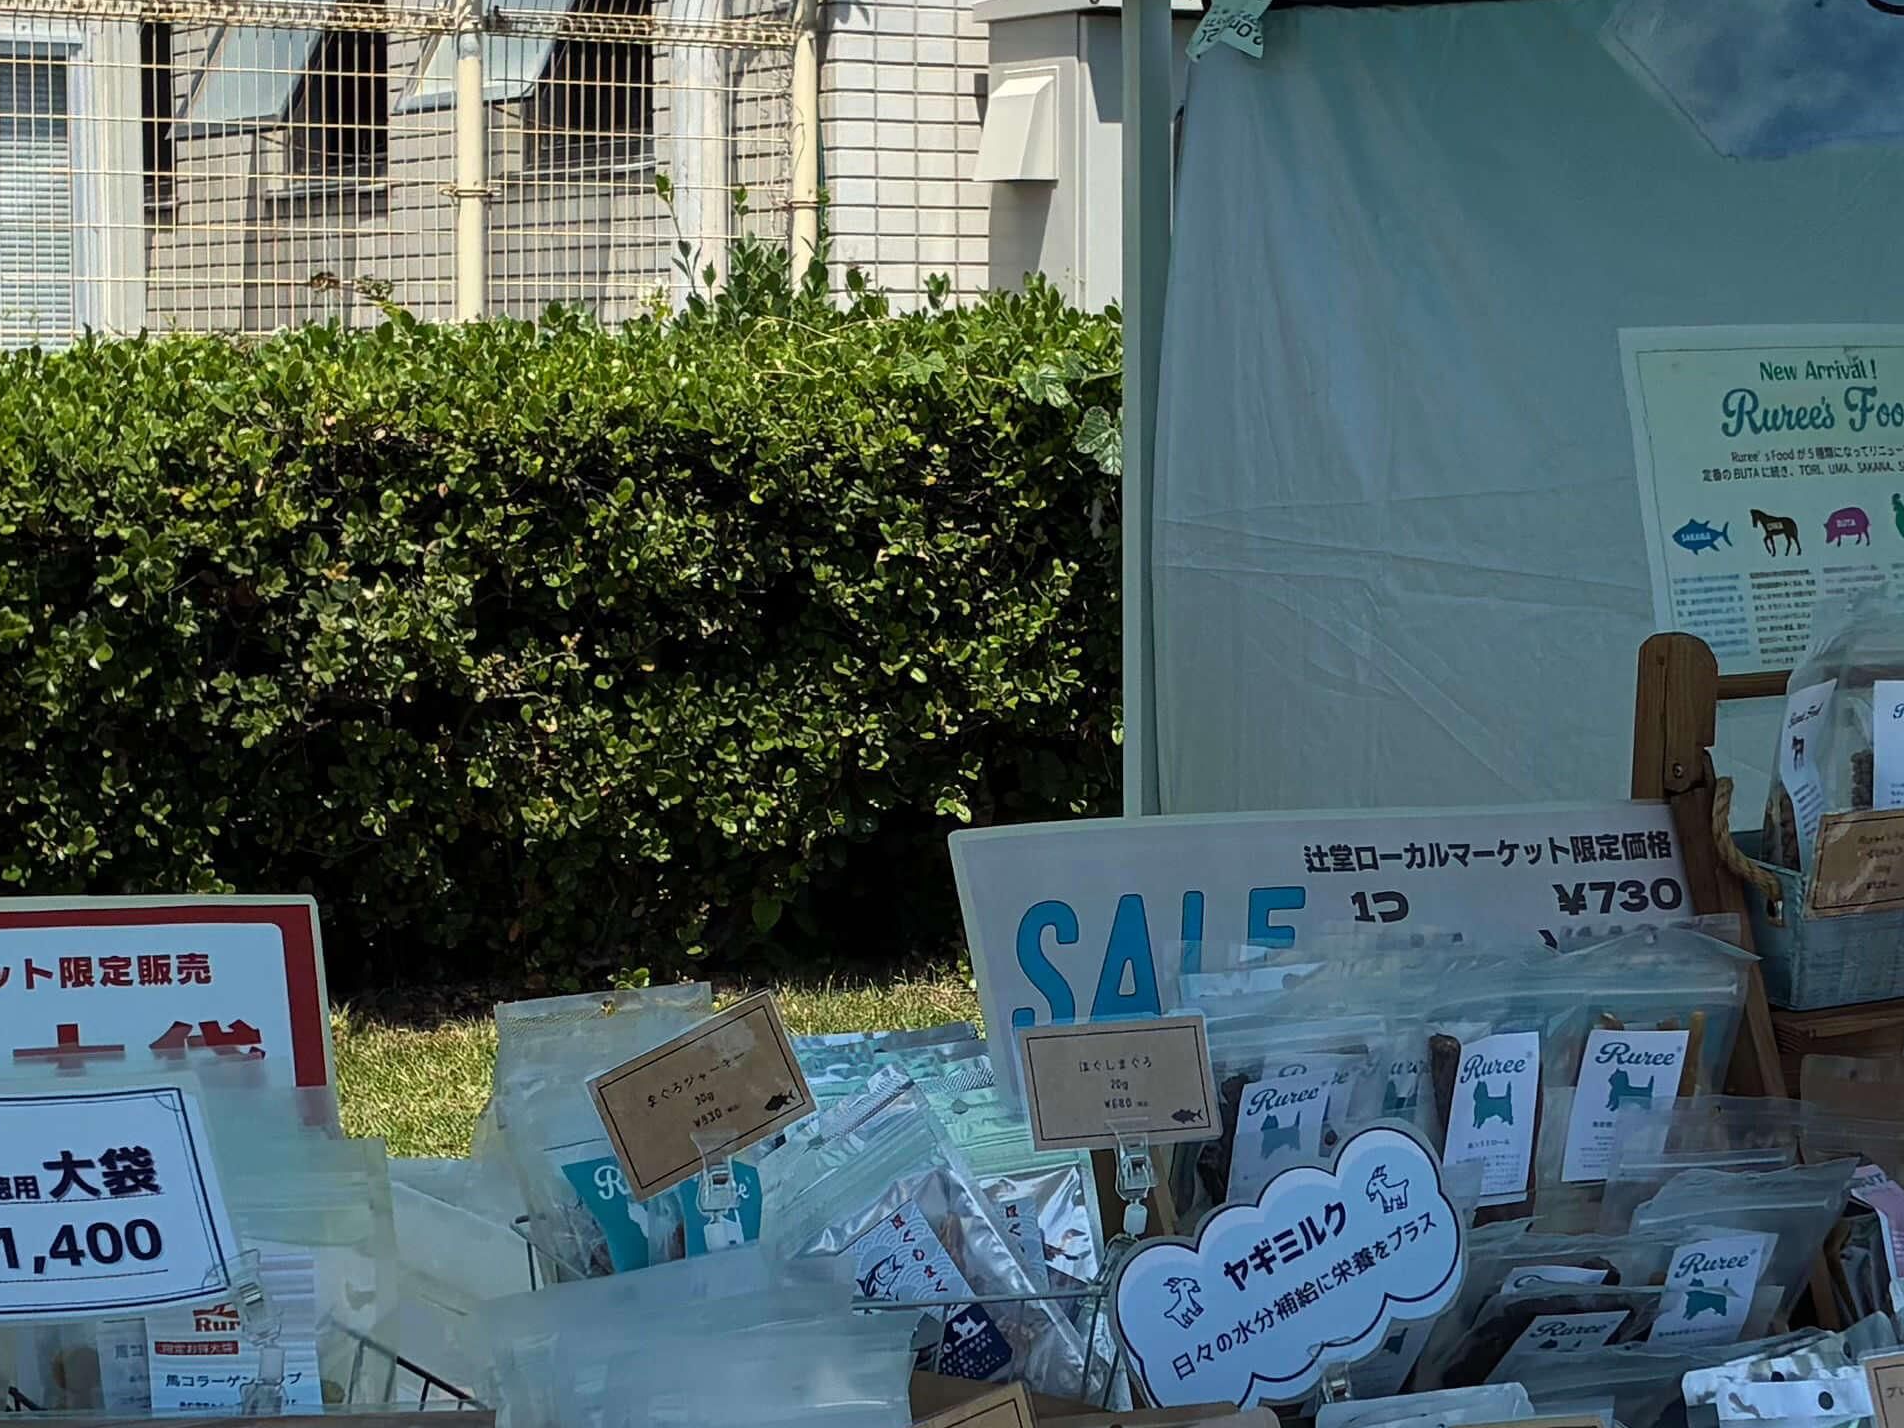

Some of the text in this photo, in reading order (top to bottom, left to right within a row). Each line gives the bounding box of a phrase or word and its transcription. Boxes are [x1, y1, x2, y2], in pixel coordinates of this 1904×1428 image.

[1759, 361, 1796, 382] New
[1304, 831, 1674, 874] 辻堂ローカルマーケット限定価格
[1352, 877, 1684, 924] 1つ ¥730
[1460, 1054, 1526, 1084] Ruree
[1596, 1042, 1676, 1066] Ruree
[1247, 1088, 1319, 1117] Ruree
[43, 1146, 162, 1200] 大袋
[1224, 1201, 1346, 1291] ヤギミルク
[1674, 1252, 1749, 1279] Ruree
[1172, 1212, 1437, 1380] 日々の水分補給に栄養をプラス
[195, 1317, 241, 1332] Rur
